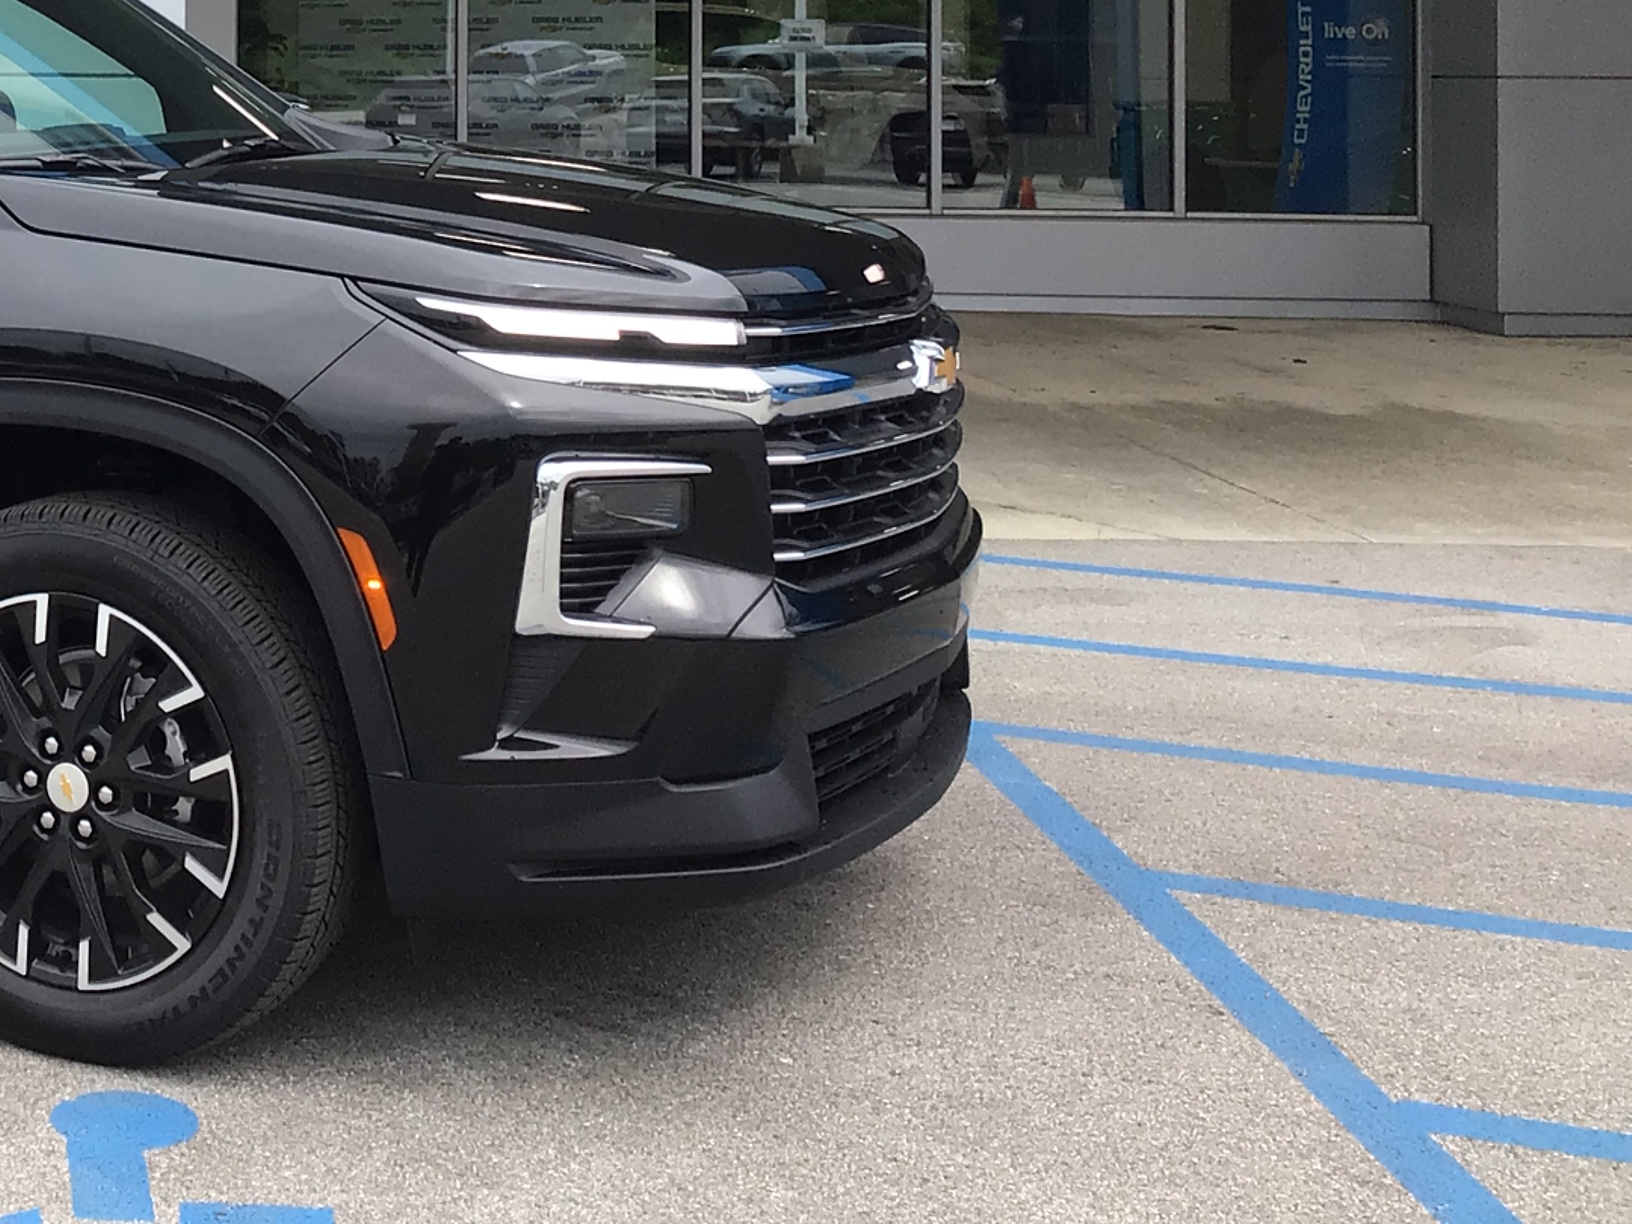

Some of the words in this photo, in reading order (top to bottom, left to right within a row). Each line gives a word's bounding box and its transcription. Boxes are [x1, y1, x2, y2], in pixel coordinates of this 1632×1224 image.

[1293, 0, 1313, 145] CHEVROLET
[1324, 21, 1356, 39] live
[1361, 23, 1389, 40] On
[144, 816, 283, 1032] CONTINENTA
